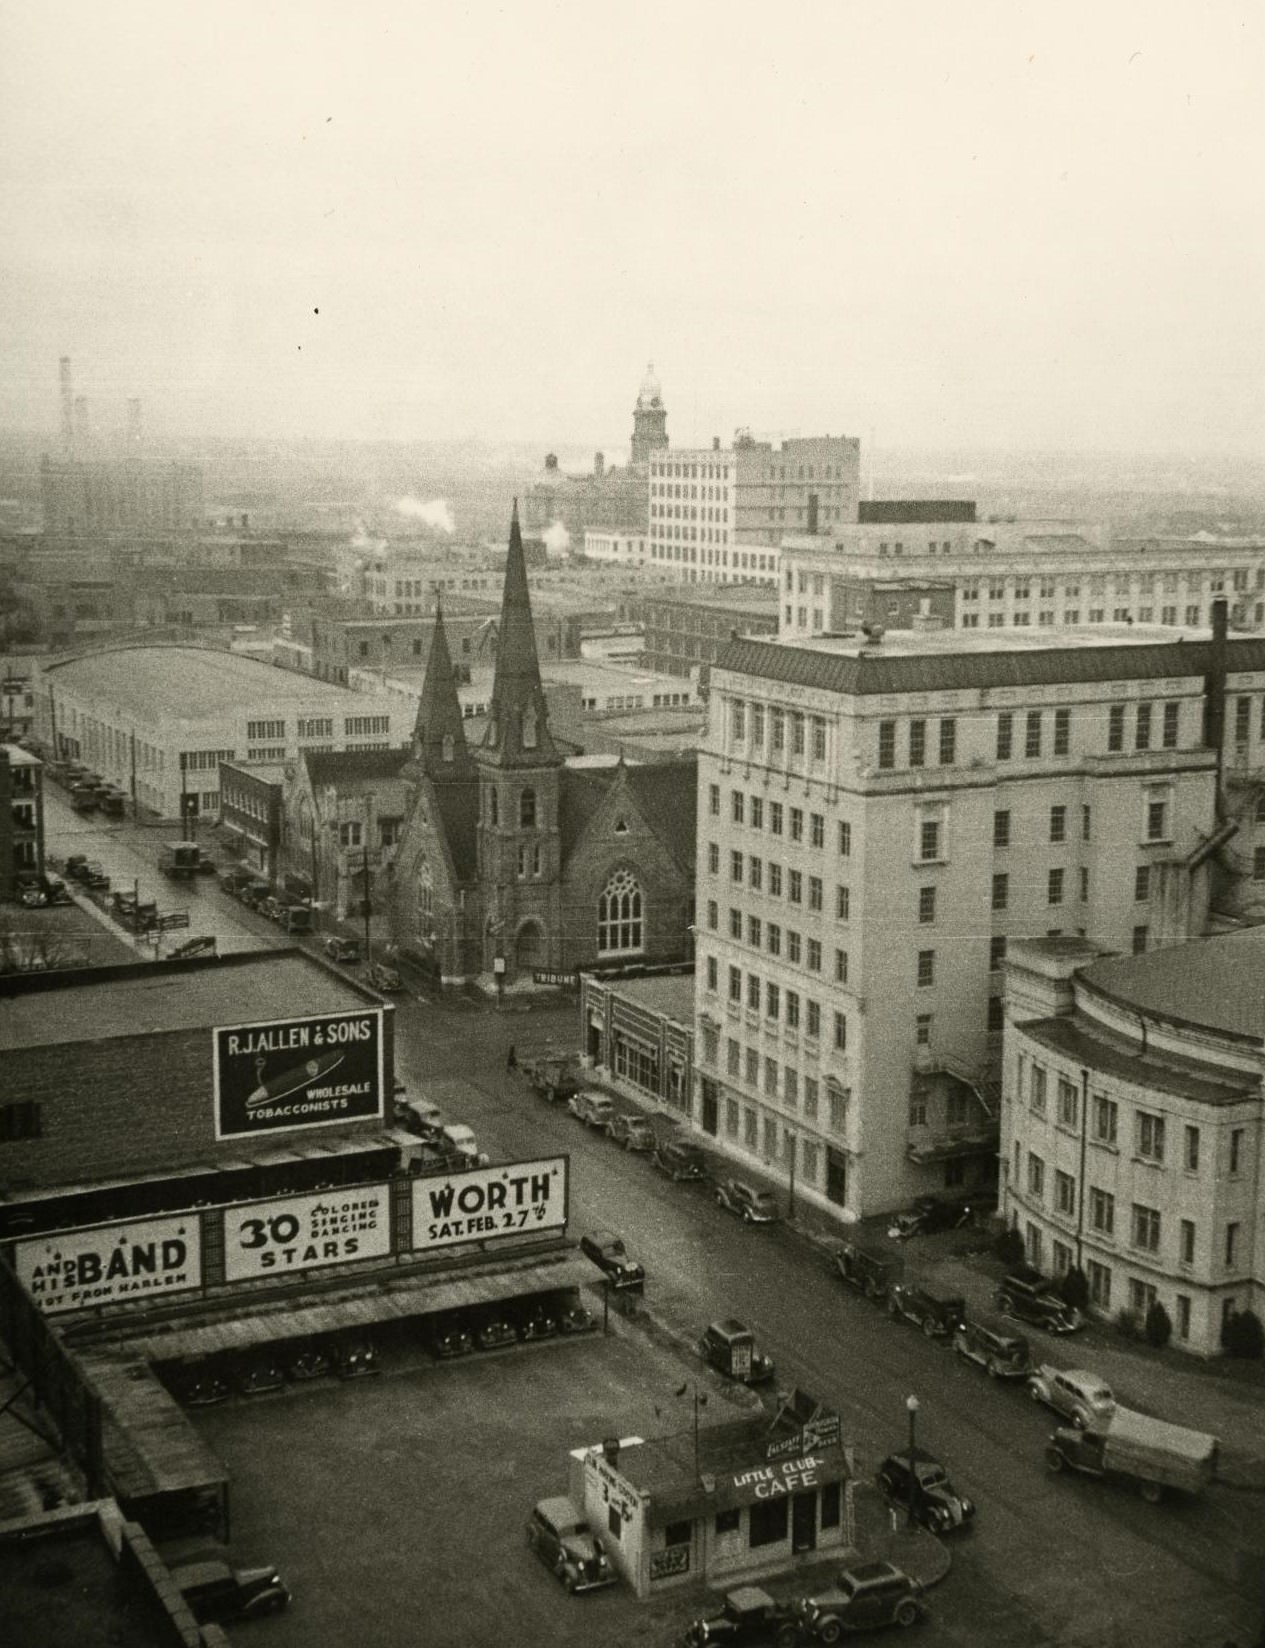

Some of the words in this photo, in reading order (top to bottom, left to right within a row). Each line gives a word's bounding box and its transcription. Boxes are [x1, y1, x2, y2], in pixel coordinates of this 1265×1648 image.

[535, 972, 576, 985] TRIBUNE
[314, 1026, 323, 1045] &
[327, 1020, 371, 1043] SONS
[306, 1082, 371, 1099] WHOLESALE
[246, 1099, 348, 1120] TOBACCONISTS
[429, 1173, 550, 1219] WORTH
[310, 1200, 379, 1217] COLORED
[311, 1210, 376, 1228] SINGING
[240, 1214, 300, 1249] 30
[310, 1221, 377, 1238] DANCING
[77, 1239, 187, 1285] BAND
[261, 1238, 359, 1267] STARS
[32, 1260, 76, 1278] AND
[32, 1275, 76, 1293] HIS
[72, 1287, 112, 1302] FROM
[119, 1274, 186, 1292] HARLEM
[734, 1466, 774, 1487] LITTLE
[754, 1470, 818, 1498] CAFE
